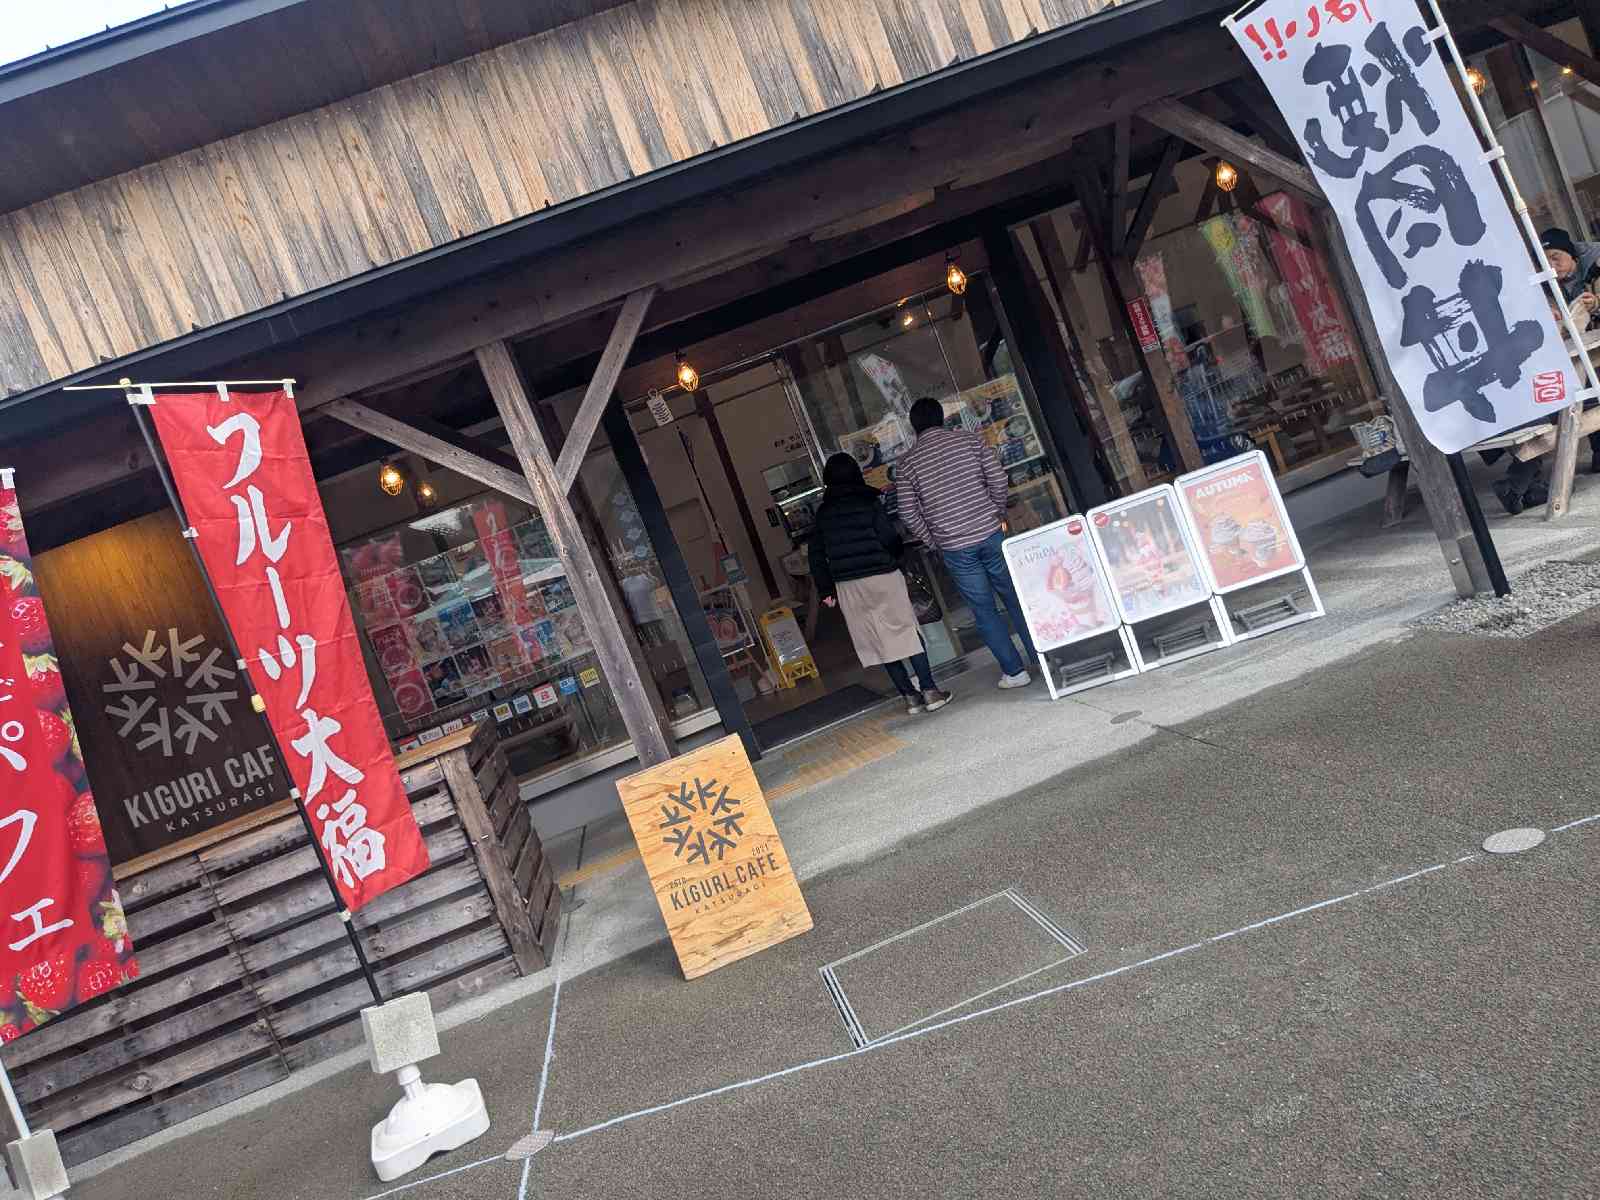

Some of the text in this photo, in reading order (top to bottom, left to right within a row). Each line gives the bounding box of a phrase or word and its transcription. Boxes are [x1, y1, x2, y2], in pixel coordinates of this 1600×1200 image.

[207, 412, 387, 889] フルーツ大福
[123, 744, 274, 828] KIGURI CAF
[165, 783, 274, 832] KATSURAGI
[670, 852, 780, 911] KIGURI CAFE
